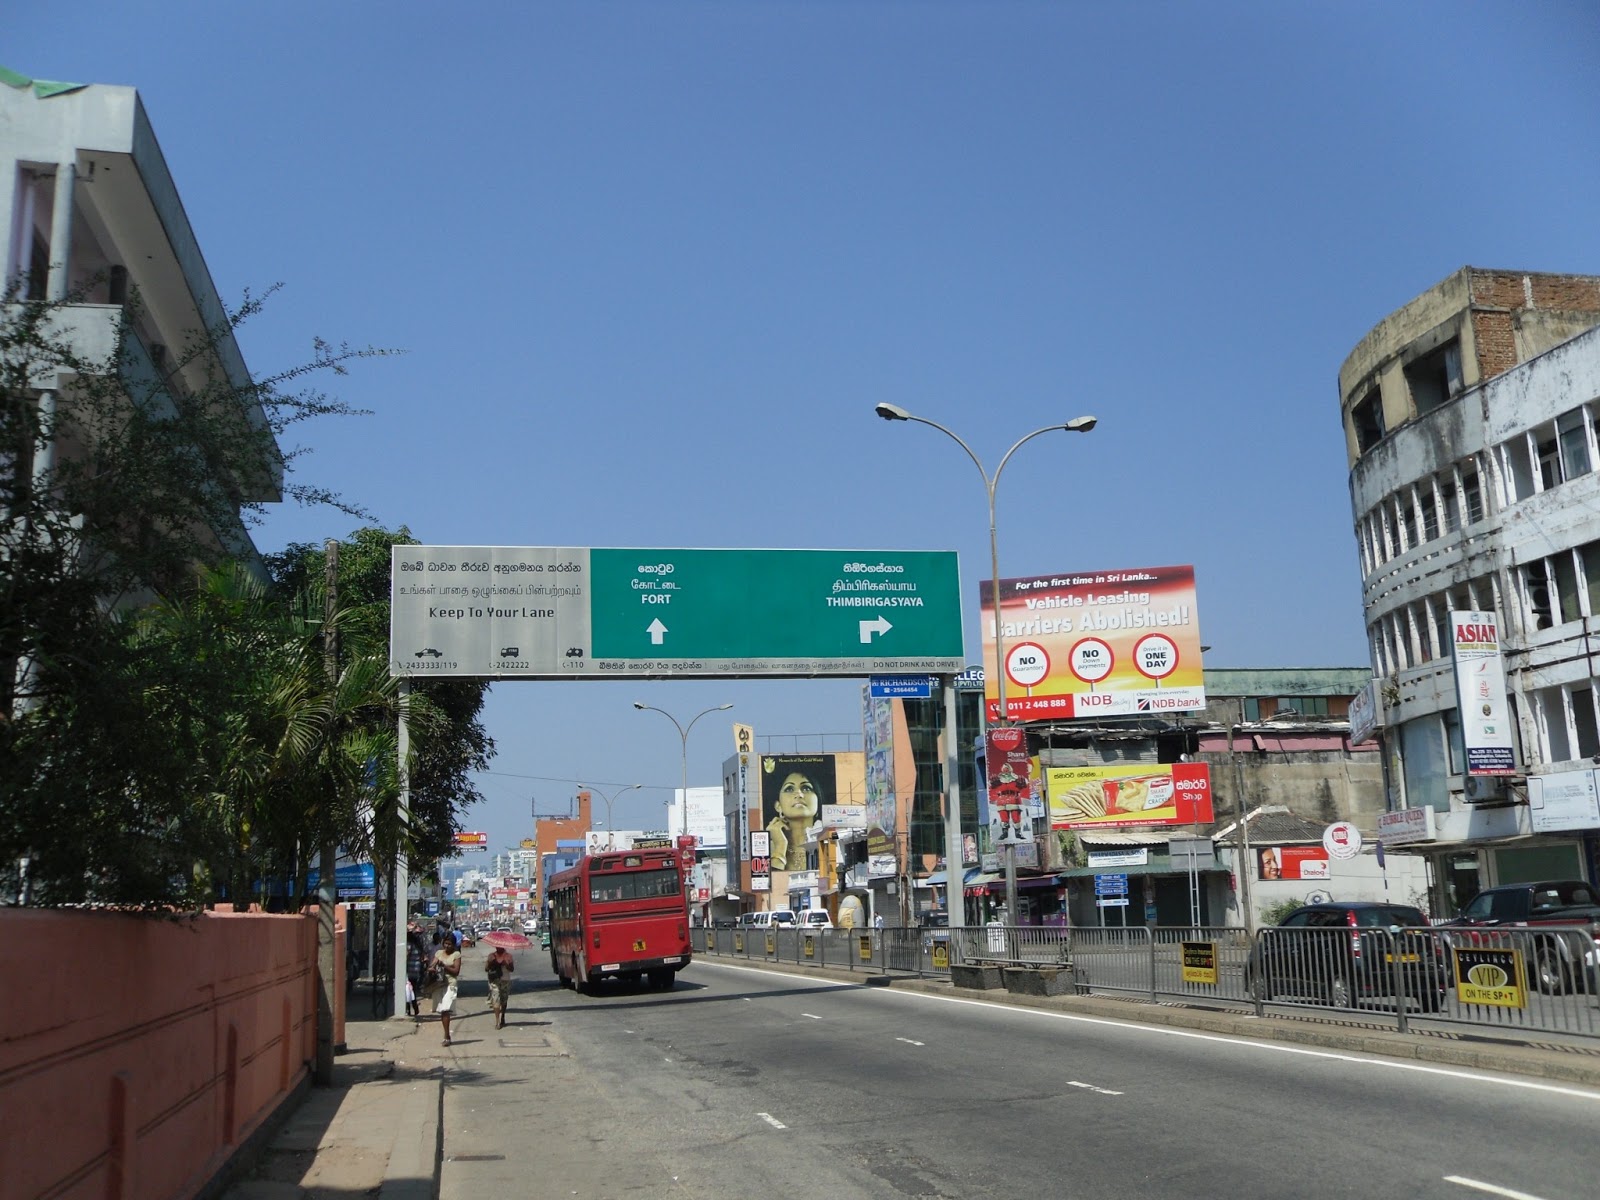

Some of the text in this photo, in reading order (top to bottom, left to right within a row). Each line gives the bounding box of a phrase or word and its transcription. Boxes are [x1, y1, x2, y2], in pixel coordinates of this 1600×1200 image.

[1015, 582, 1031, 590] For
[1033, 580, 1048, 588] the
[1051, 578, 1070, 587] first
[1072, 576, 1093, 585] time
[1095, 575, 1105, 583] in
[1107, 574, 1120, 582] Sri
[641, 594, 671, 604] FORT
[826, 597, 923, 607] THIMBIRIGASYAYA
[1024, 590, 1150, 610] Vehicle Leasing
[429, 607, 554, 619] Keep To Your Lane
[1080, 605, 1189, 632] Abolished!
[1456, 624, 1497, 643] ASIAN
[1082, 649, 1099, 658] NO
[1145, 652, 1167, 660] ONE
[1019, 656, 1036, 665] NO
[1146, 660, 1167, 668] DAY
[880, 679, 929, 687] RICHARDSON
[1008, 702, 1023, 710] 011
[1033, 700, 1048, 708] 448
[1050, 699, 1066, 707] 888
[1081, 695, 1112, 707] NDB
[1152, 697, 1200, 709] NDB bank
[1475, 967, 1500, 986] VIP
[1466, 989, 1476, 998] ON
[1477, 989, 1491, 999] THE
